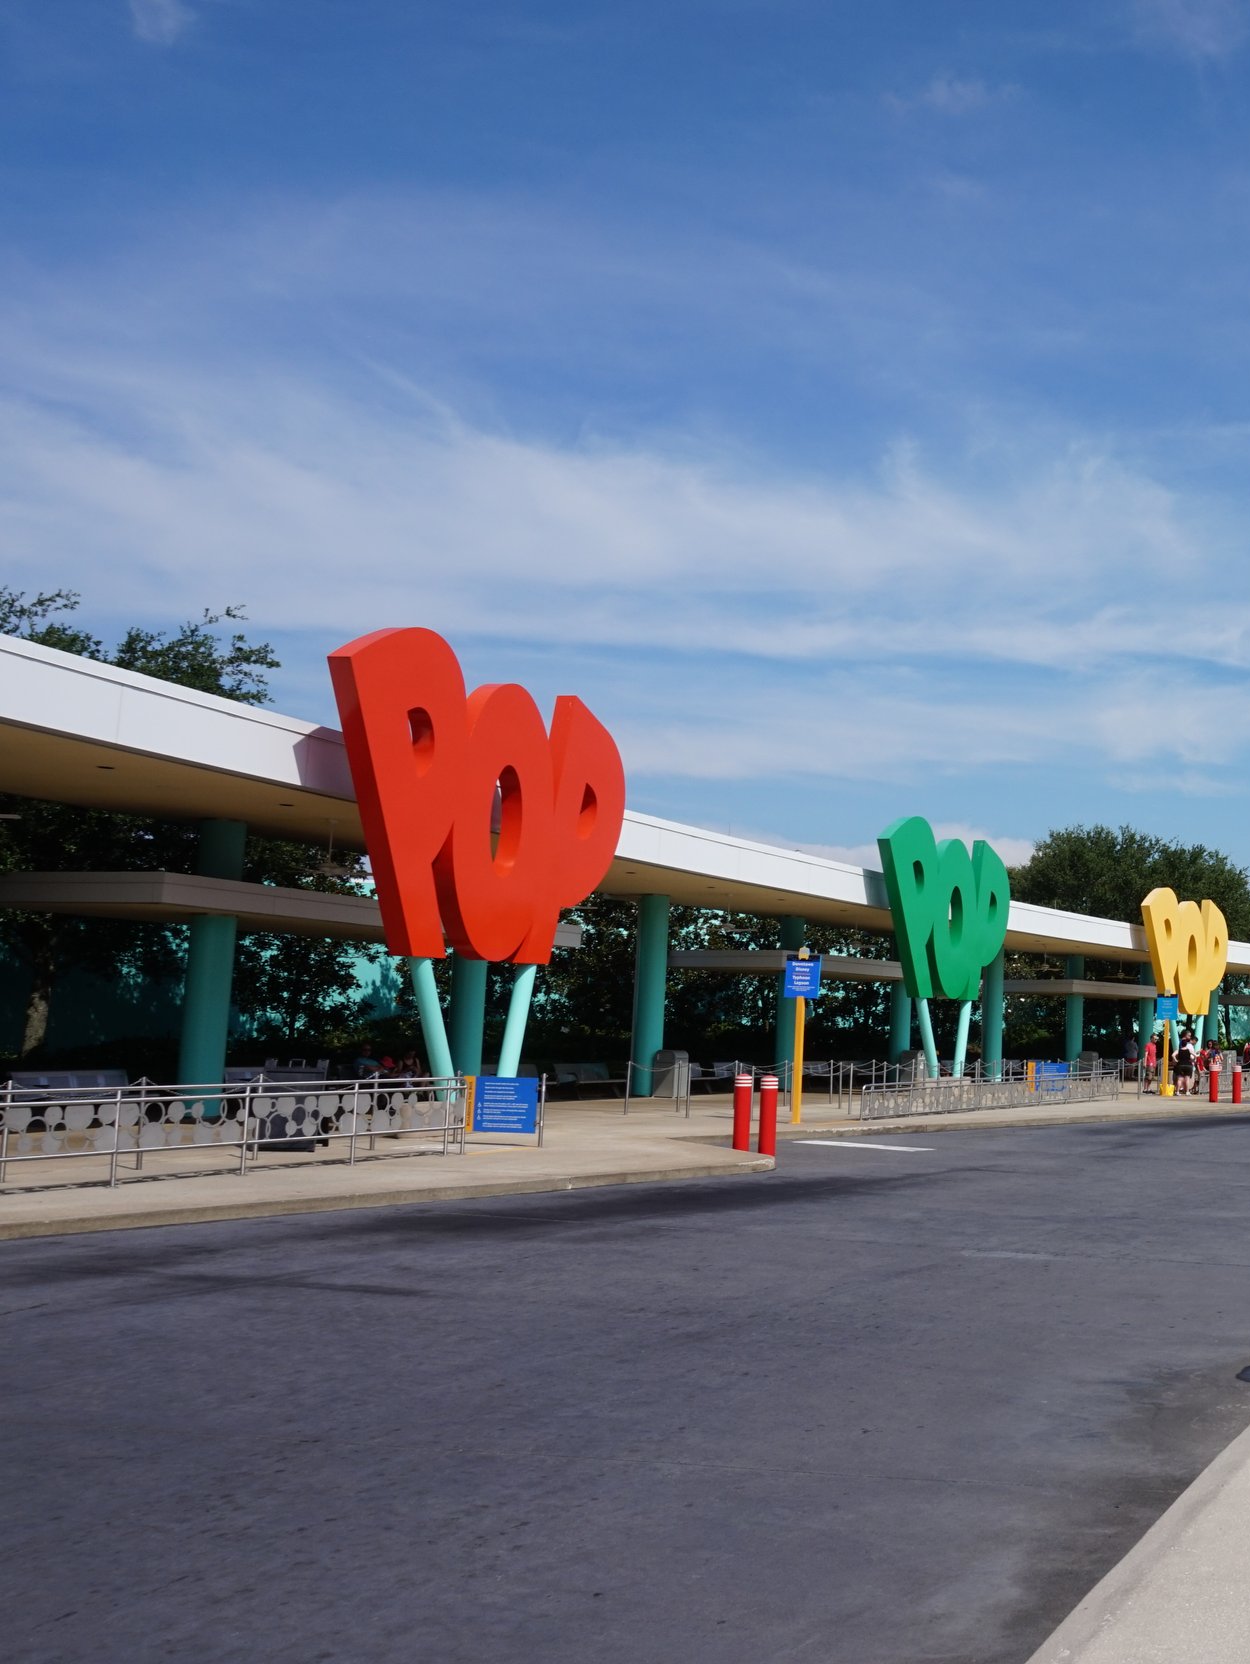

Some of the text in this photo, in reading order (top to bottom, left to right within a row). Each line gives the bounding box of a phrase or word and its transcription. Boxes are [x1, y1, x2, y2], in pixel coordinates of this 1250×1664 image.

[328, 627, 626, 965] POP
[877, 816, 1010, 1001] POP
[1141, 887, 1228, 1015] POP
